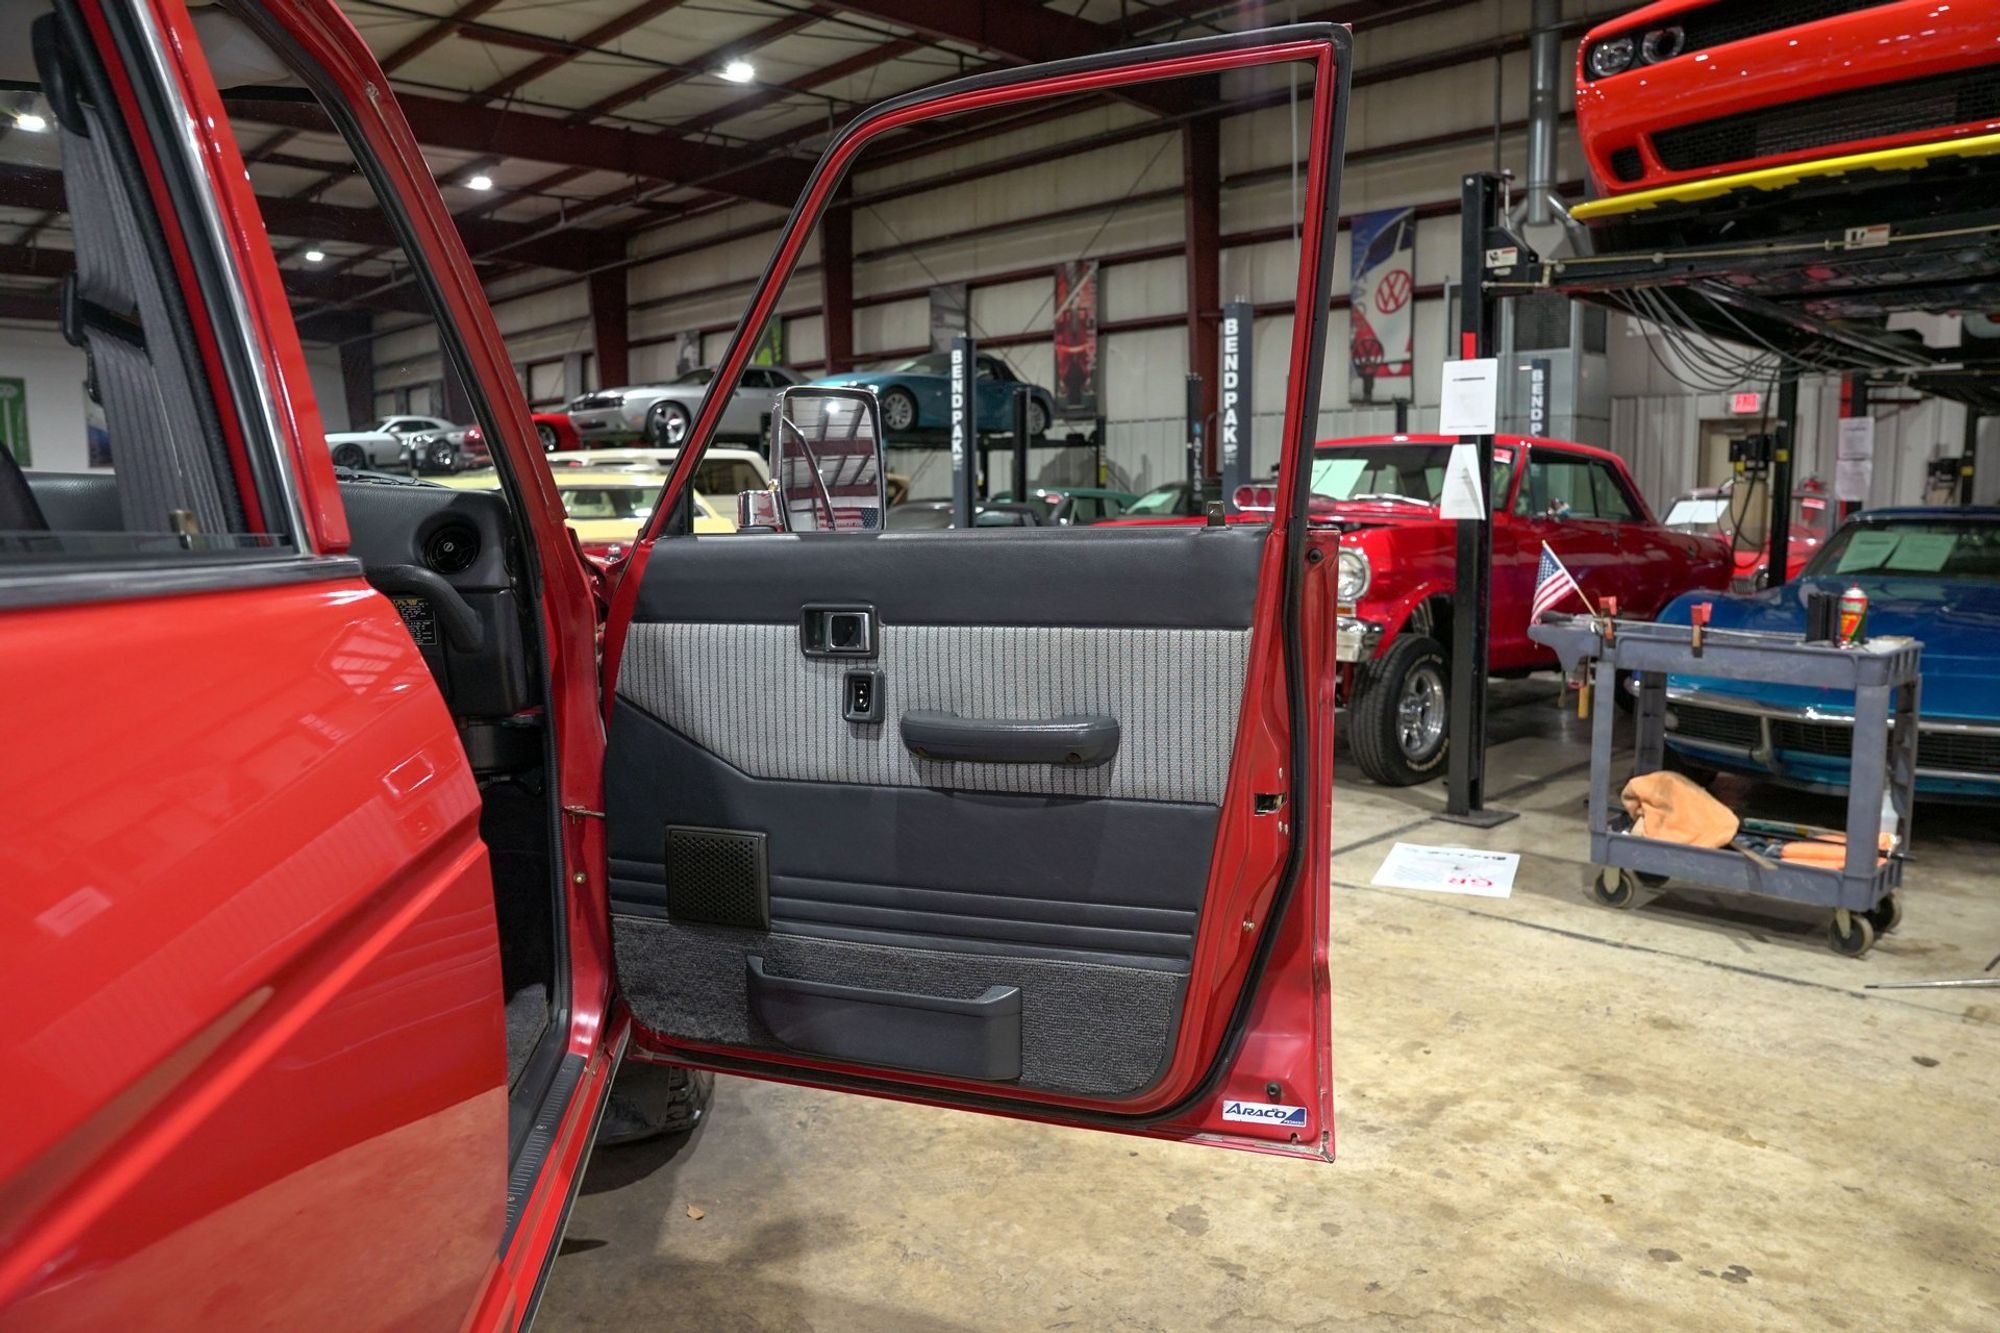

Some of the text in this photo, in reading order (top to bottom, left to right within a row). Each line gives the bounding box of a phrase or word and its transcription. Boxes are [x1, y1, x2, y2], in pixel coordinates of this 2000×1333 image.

[951, 350, 963, 453] BENDPAK
[1223, 318, 1239, 443] BENDPAK
[1531, 369, 1544, 437] BENDP
[1225, 1103, 1287, 1119] ARACO
